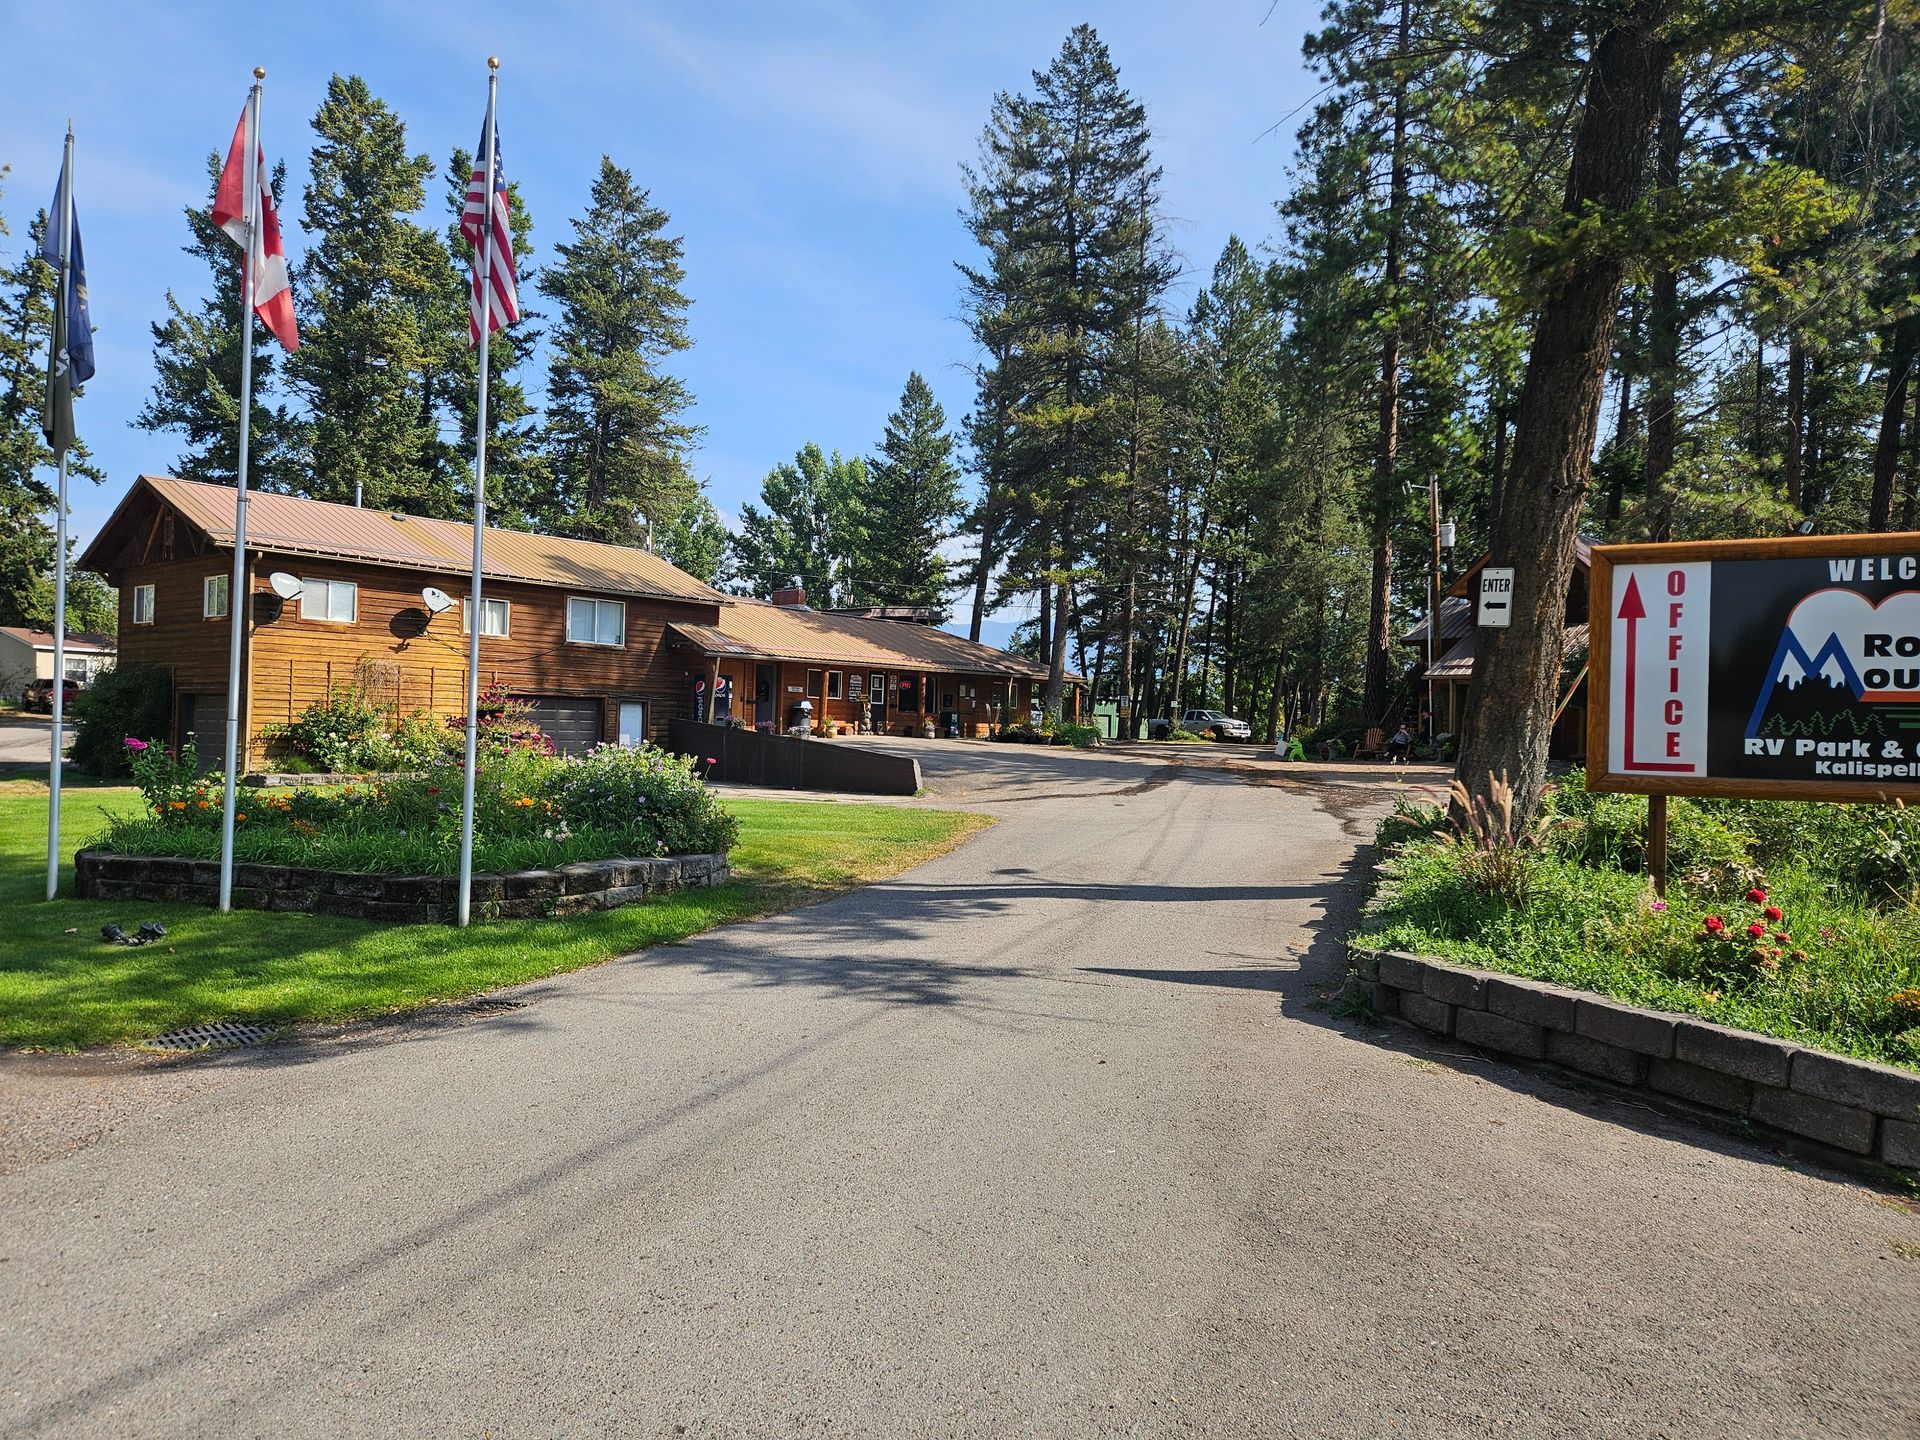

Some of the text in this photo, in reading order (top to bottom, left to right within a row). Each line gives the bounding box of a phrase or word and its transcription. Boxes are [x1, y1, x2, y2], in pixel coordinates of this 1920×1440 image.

[1829, 557, 1918, 582] WELC
[1482, 578, 1511, 593] ENTER
[1863, 634, 1920, 658] RO
[1664, 570, 1686, 757] OFFICE
[1744, 738, 1785, 756] RV
[1795, 739, 1871, 758] Park
[1881, 740, 1905, 759] &
